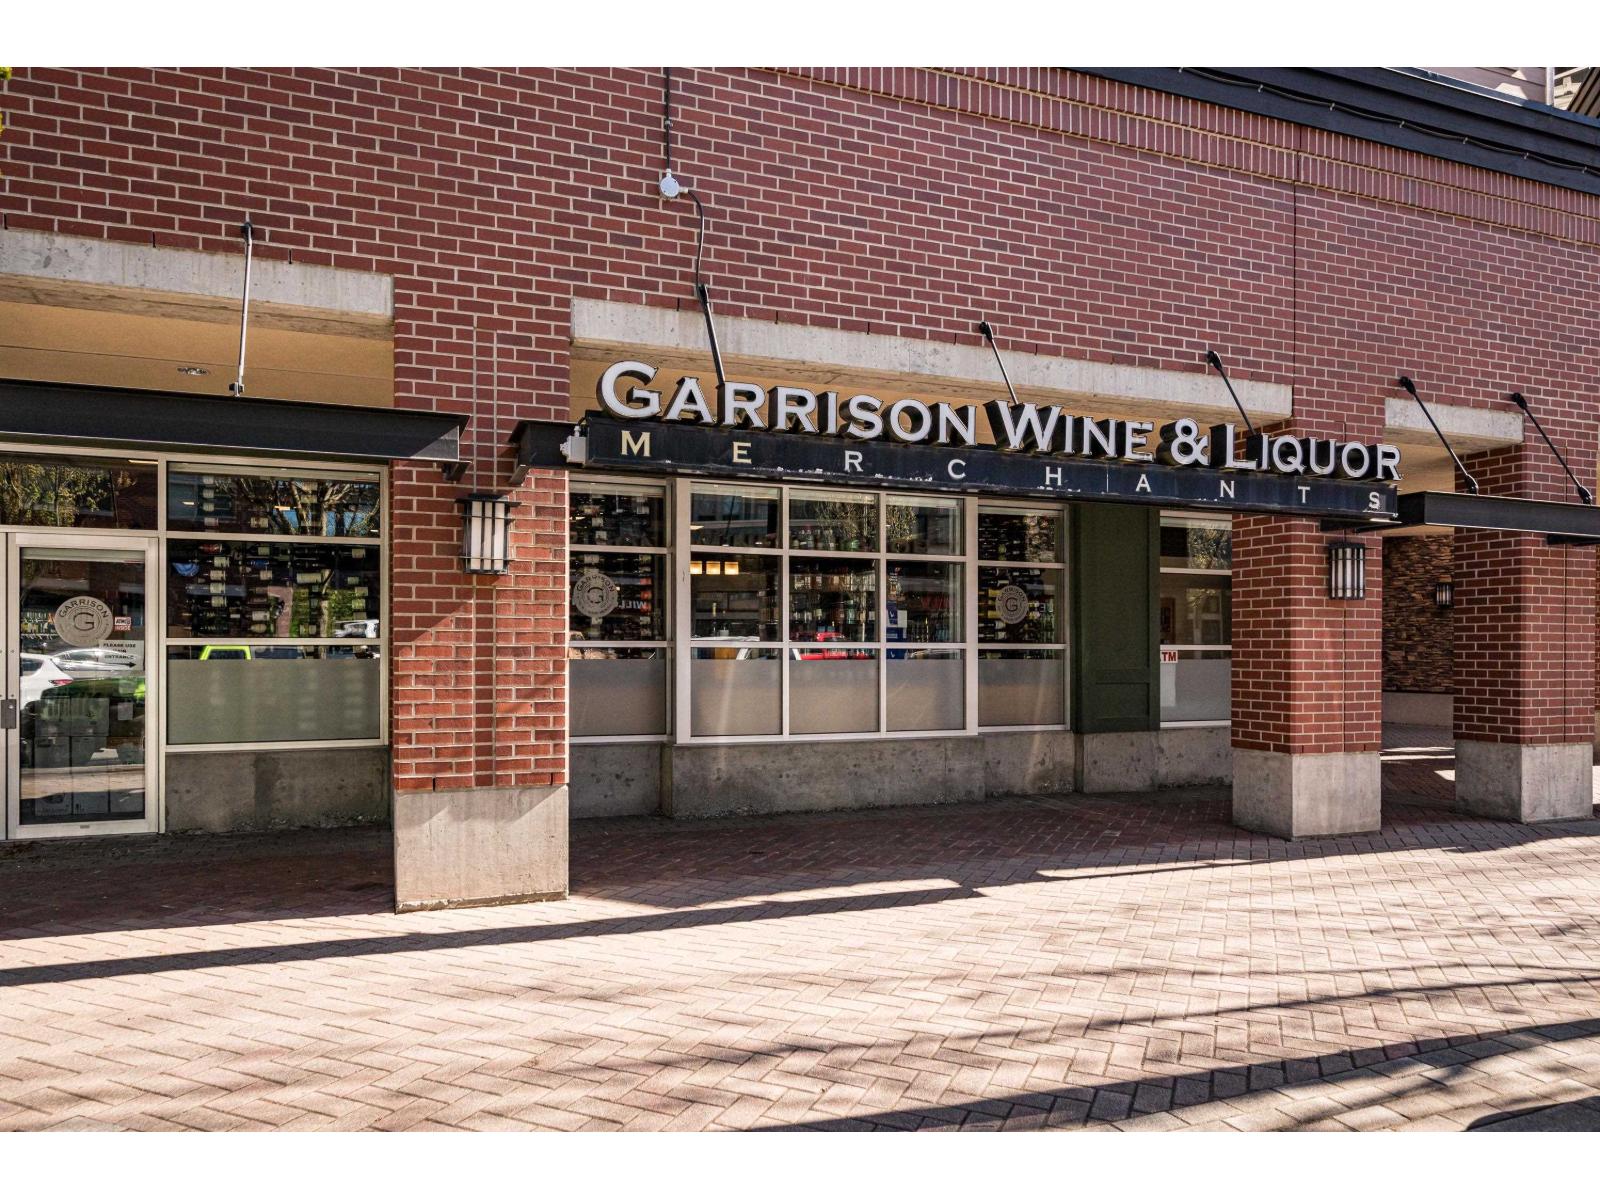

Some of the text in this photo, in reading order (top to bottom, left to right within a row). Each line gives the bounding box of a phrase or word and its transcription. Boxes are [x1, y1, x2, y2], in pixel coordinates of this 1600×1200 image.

[597, 360, 1403, 481] GARRISON WINE & LIQUOR
[620, 429, 1381, 510] MERCHANTS
[59, 599, 109, 618] GARRISON
[1005, 597, 1019, 612] G
[73, 612, 95, 631] G
[1160, 651, 1177, 662] TM
